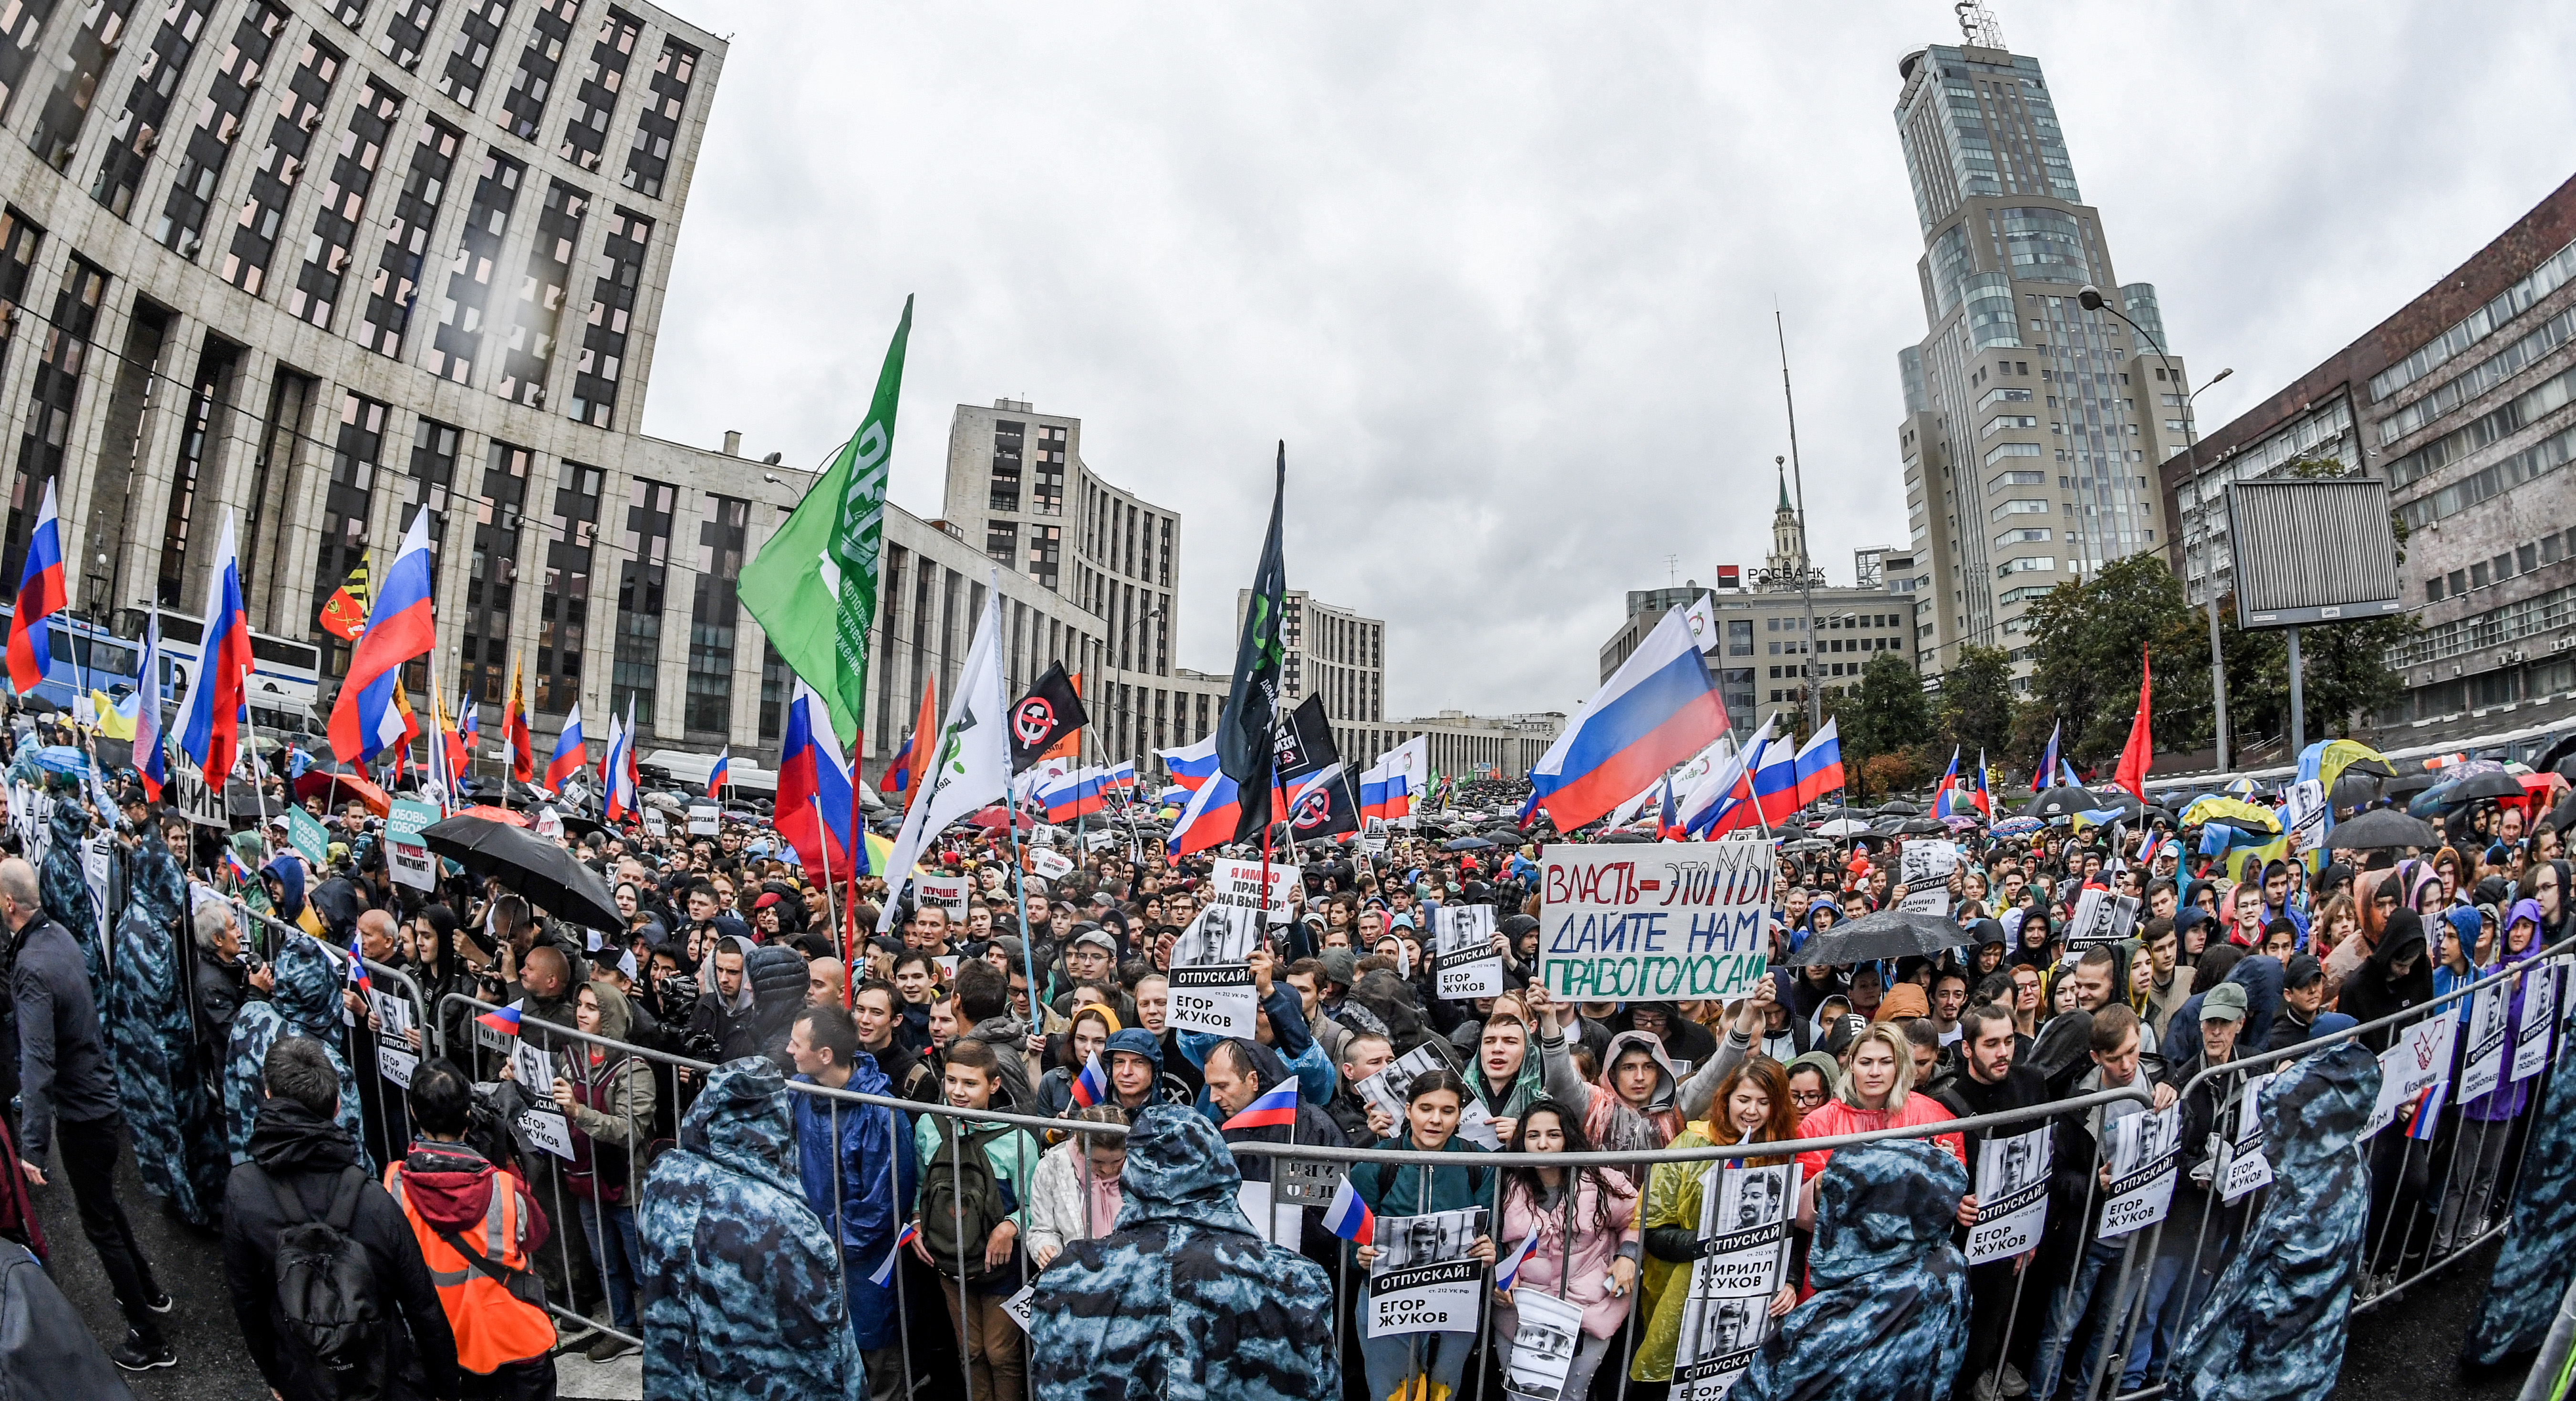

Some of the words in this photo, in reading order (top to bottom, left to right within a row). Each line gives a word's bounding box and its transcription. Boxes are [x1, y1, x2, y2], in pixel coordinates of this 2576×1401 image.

[1748, 567, 1826, 580] РОСБАНК
[293, 816, 321, 844] ЛЮБОВЬ
[391, 820, 426, 835] СОБОЛ
[295, 832, 322, 858] СОБОЛЬ
[396, 842, 424, 858] ЛУЧШЕ
[396, 854, 429, 873] МИТИНГ!
[1043, 862, 1065, 873] МИТИНГ!
[1047, 857, 1065, 867] ЛУЧШЕ
[1230, 868, 1239, 878] Я
[1241, 868, 1280, 883] ИМЮ
[923, 886, 958, 898] ЛУЧШЕ
[1910, 877, 1948, 892] ТПУСКАЙ!
[920, 895, 962, 908] МИТИНГ!
[1217, 892, 1234, 906] НА
[1236, 895, 1286, 912] ВЫБОР!
[1901, 899, 1936, 908] ДАНИИЛ
[1548, 910, 1669, 953] ДАЙТЕ
[1687, 908, 1759, 953] НАМ
[1443, 946, 1492, 967] ОТПУСКАЙ
[1178, 969, 1250, 983] ОТПУСКАЙ!
[1444, 973, 1470, 983] ЕГОР
[1544, 956, 1637, 996] ПРАВО
[1443, 983, 1485, 993] ЖУКОВ
[1177, 995, 1213, 1010] ЕГОР
[1174, 1008, 1231, 1027] ЖУКОВ
[382, 1052, 400, 1067] ЕГОР
[383, 1062, 409, 1083] ЖУКОВ
[523, 1117, 546, 1132] ЕГОР
[526, 1128, 560, 1148] ЖУКОВ
[2236, 1135, 2263, 1156] ОТПУС
[2114, 1156, 2173, 1193] ОТПУСКАЙ!
[2232, 1161, 2254, 1178] ЕГОР
[2228, 1170, 2262, 1192] ЖУКОВ
[1978, 1183, 2045, 1221] ОТПУСКАЙ!
[2109, 1199, 2143, 1215] ЕГОР
[2106, 1206, 2154, 1228] ЖУКОВ
[1975, 1226, 2011, 1244] ЕГОР
[1972, 1234, 2026, 1257] ЖУКОВ
[1701, 1260, 1773, 1276] КИРИЛЛ
[1381, 1265, 1470, 1289] ОТПУСКАЙ!
[1698, 1276, 1762, 1289] ЖУКОВ
[1380, 1299, 1426, 1313] ЕГОР
[1378, 1312, 1448, 1328] ЖУКОВ
